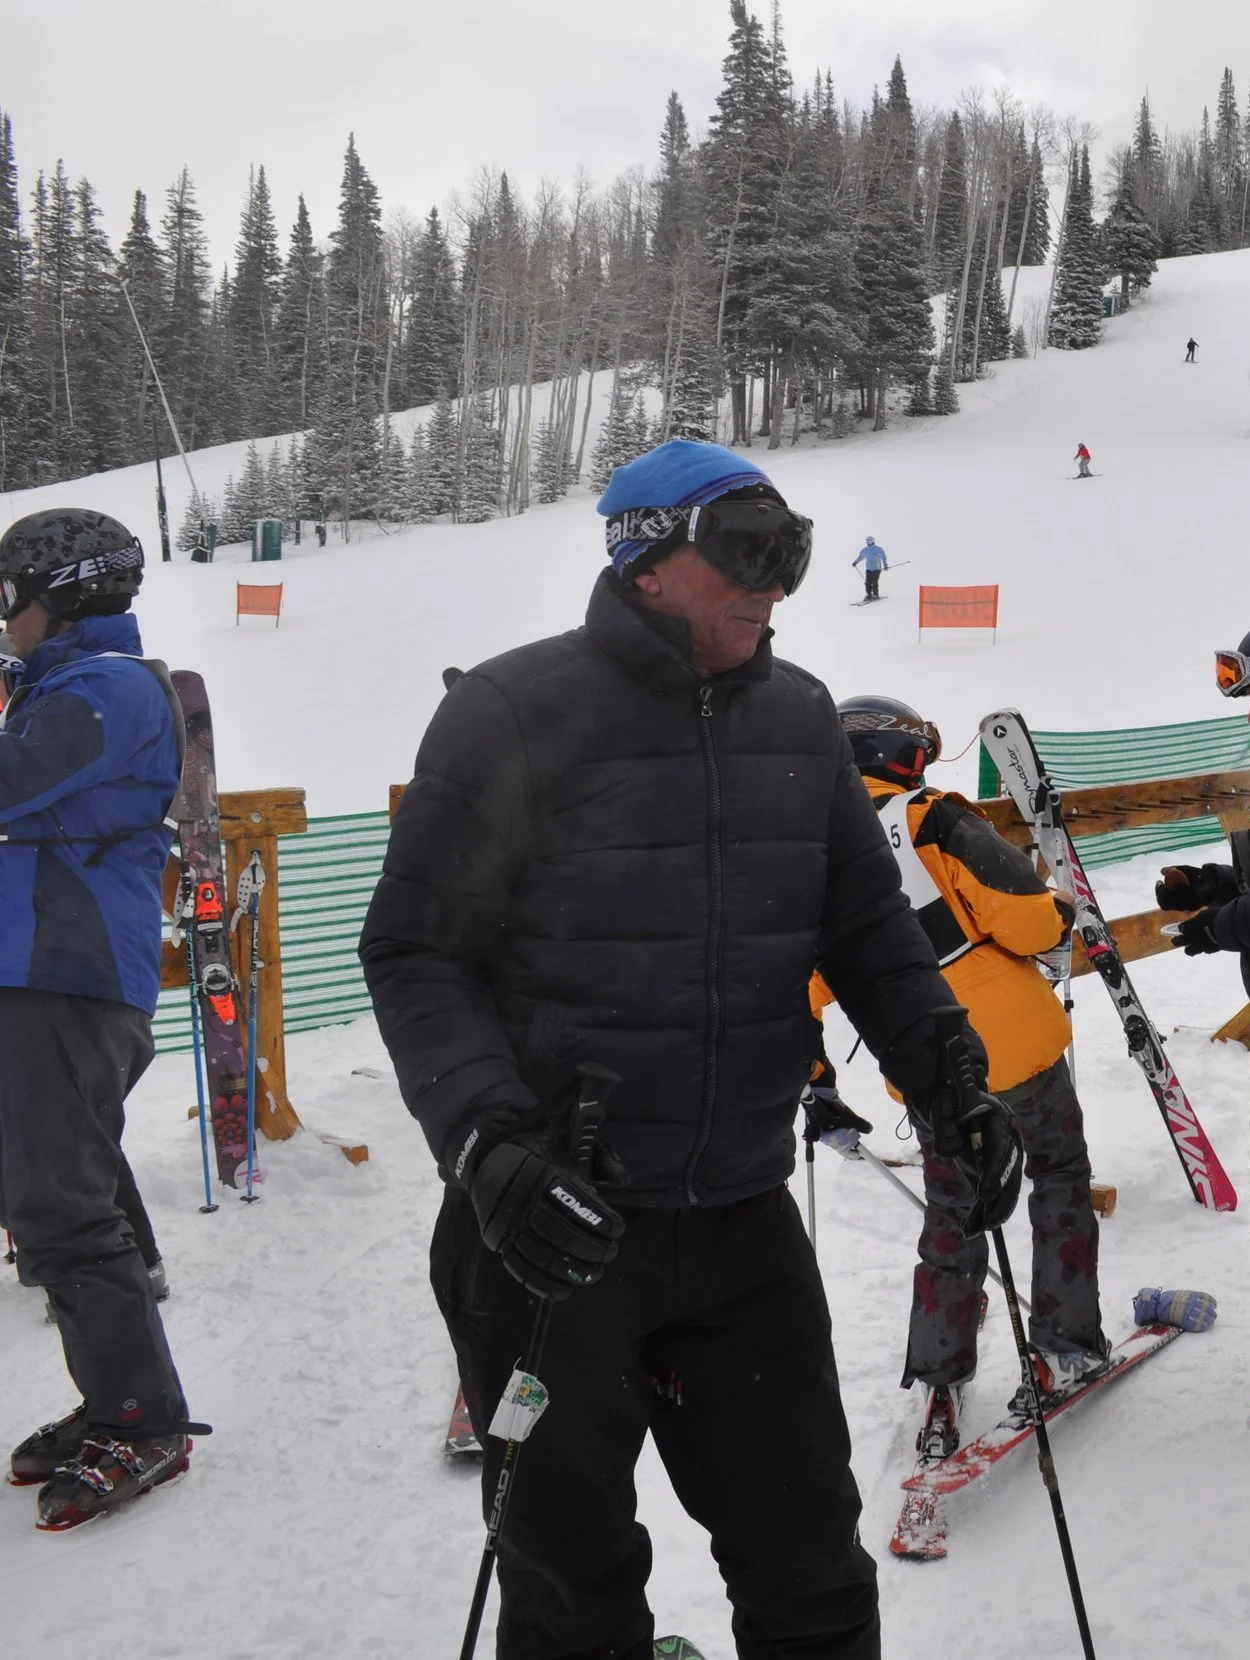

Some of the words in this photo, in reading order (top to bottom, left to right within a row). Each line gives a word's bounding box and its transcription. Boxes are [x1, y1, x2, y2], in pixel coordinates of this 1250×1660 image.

[877, 714, 934, 739] Zeal
[890, 824, 901, 850] 5
[454, 1128, 480, 1179] KOMBI
[551, 1186, 603, 1226] KOMBI
[484, 1468, 510, 1551] HEAD
